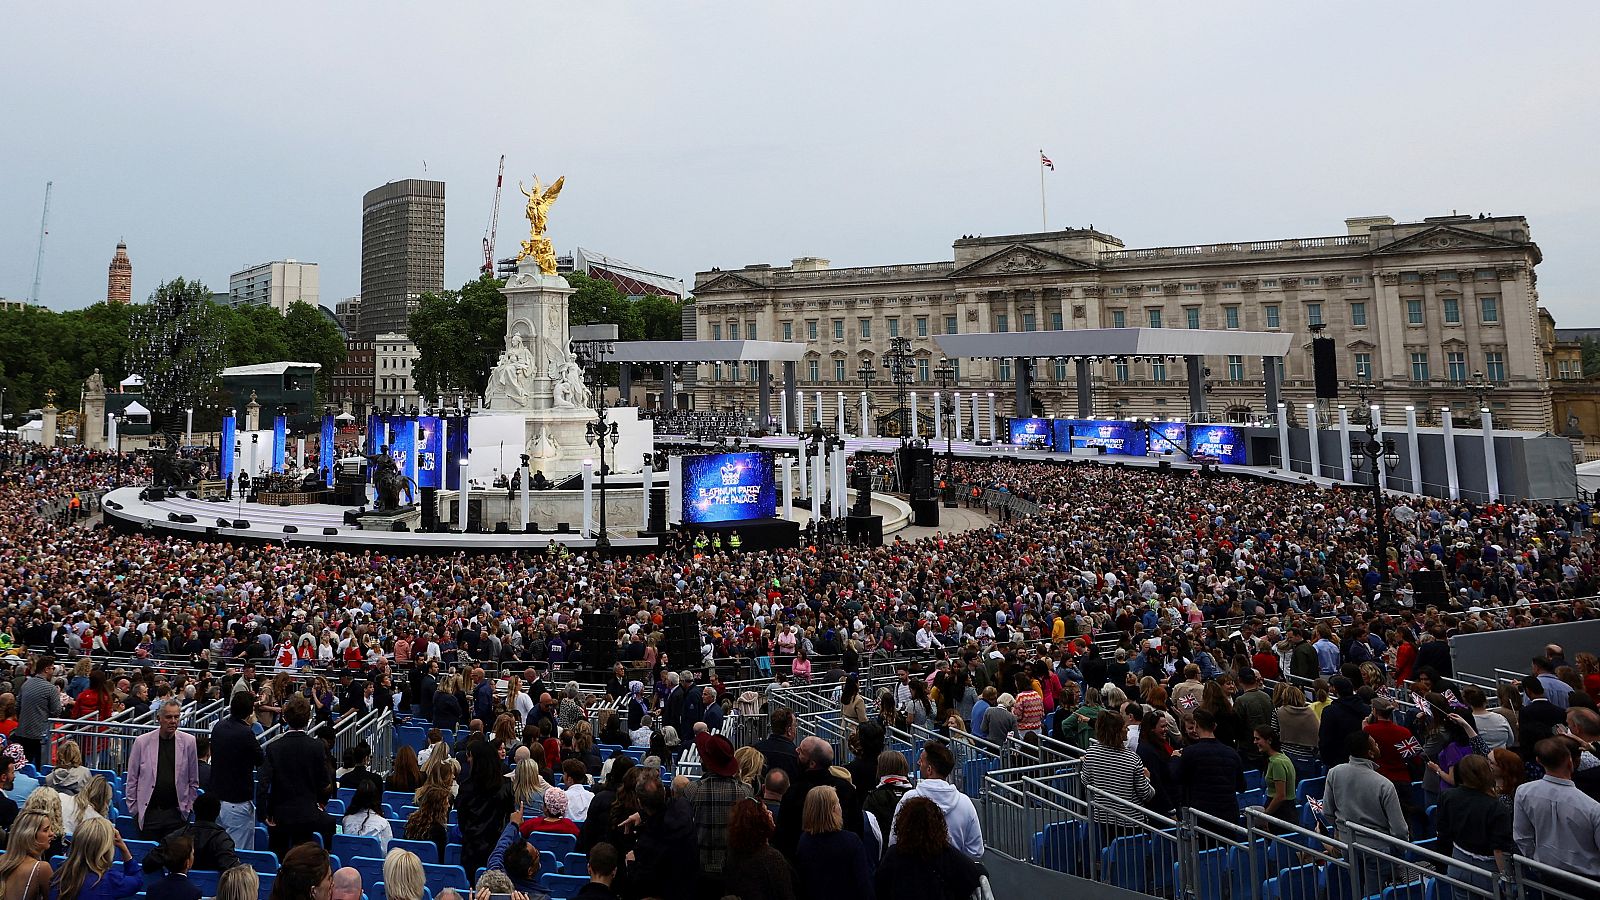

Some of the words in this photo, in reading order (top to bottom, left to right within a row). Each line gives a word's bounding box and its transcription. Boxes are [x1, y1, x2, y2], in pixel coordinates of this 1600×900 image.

[699, 486, 737, 497] PLATINUM
[738, 486, 761, 494] PARTY
[715, 495, 730, 505] THE
[731, 495, 758, 504] PALACE
